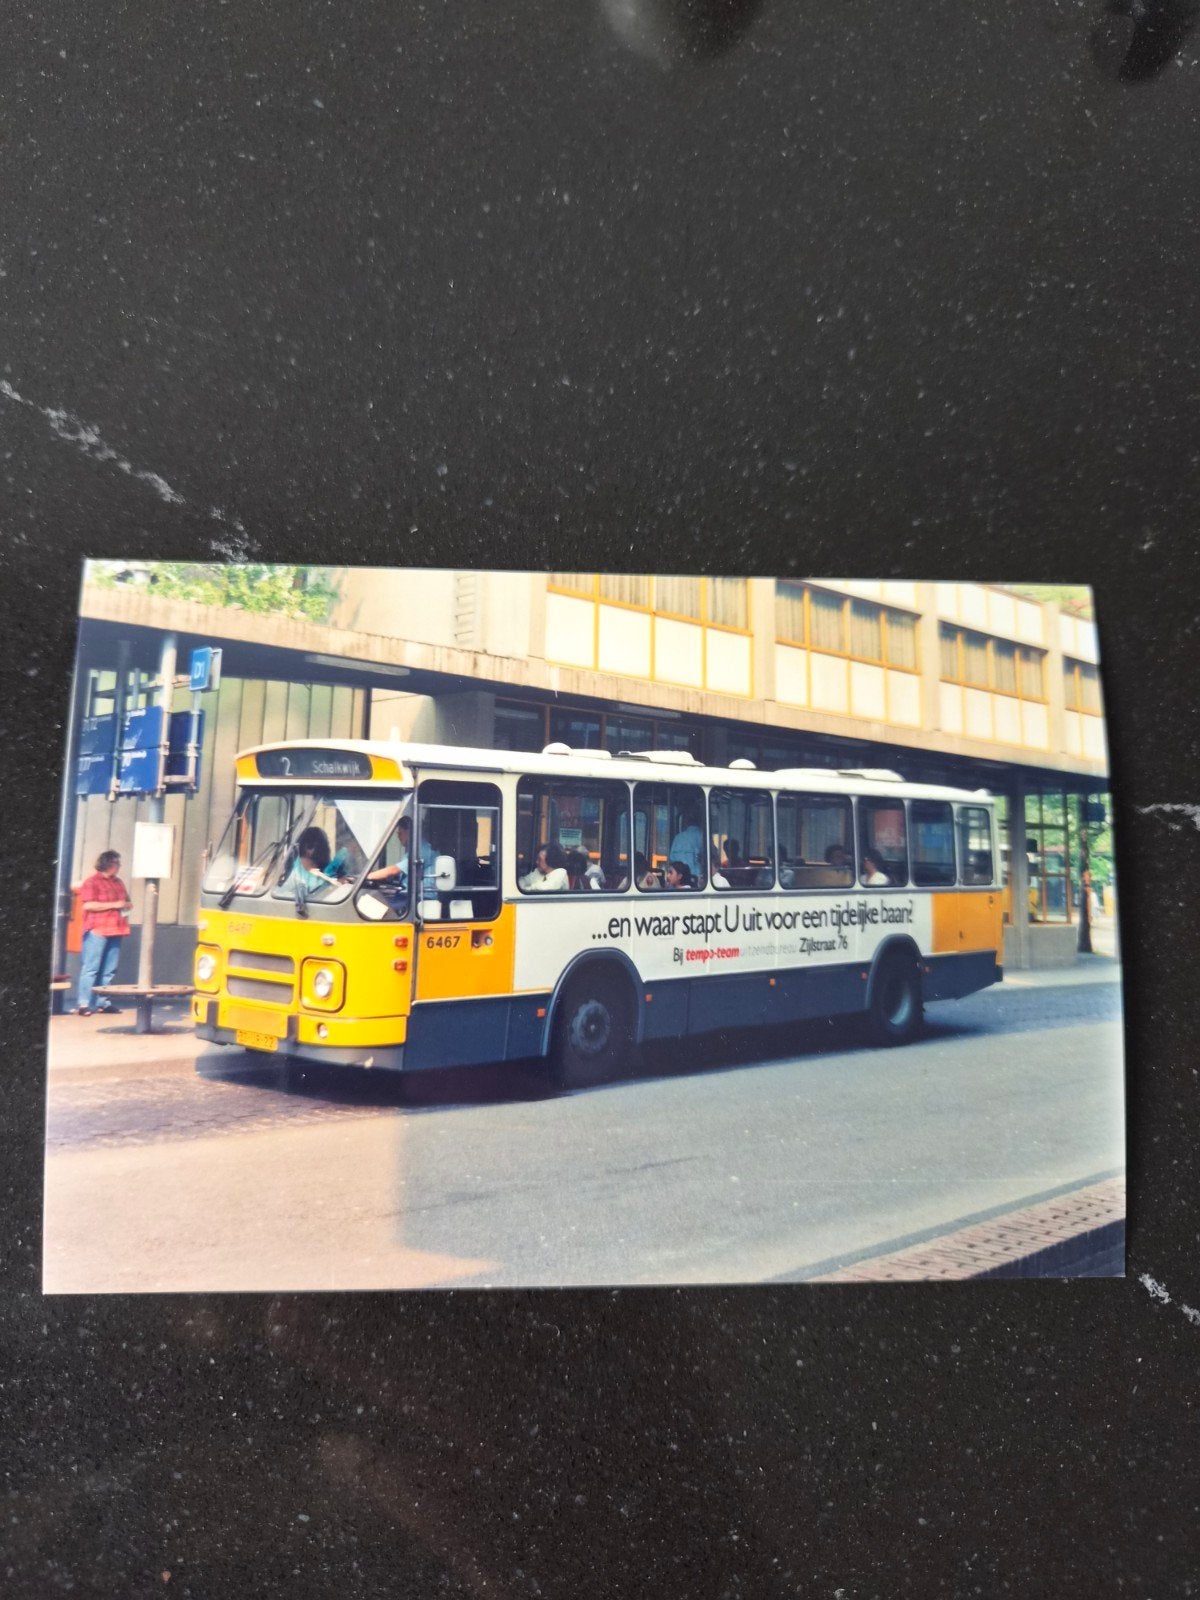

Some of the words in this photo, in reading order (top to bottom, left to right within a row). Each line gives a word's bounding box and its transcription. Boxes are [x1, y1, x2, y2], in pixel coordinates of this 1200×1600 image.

[281, 756, 293, 776] 2
[312, 760, 361, 776] Schalkwijk
[634, 915, 680, 937] waar
[682, 912, 722, 943] stapt
[725, 904, 739, 933] U
[742, 908, 763, 931] uit
[764, 911, 800, 931] voor
[802, 909, 828, 929] een
[829, 900, 879, 934] tijdelijke
[426, 935, 461, 949] 6467
[673, 947, 684, 966] Bij
[685, 946, 740, 964] tempo-team
[799, 937, 836, 956] Zijlstraat
[837, 934, 849, 950] 76
